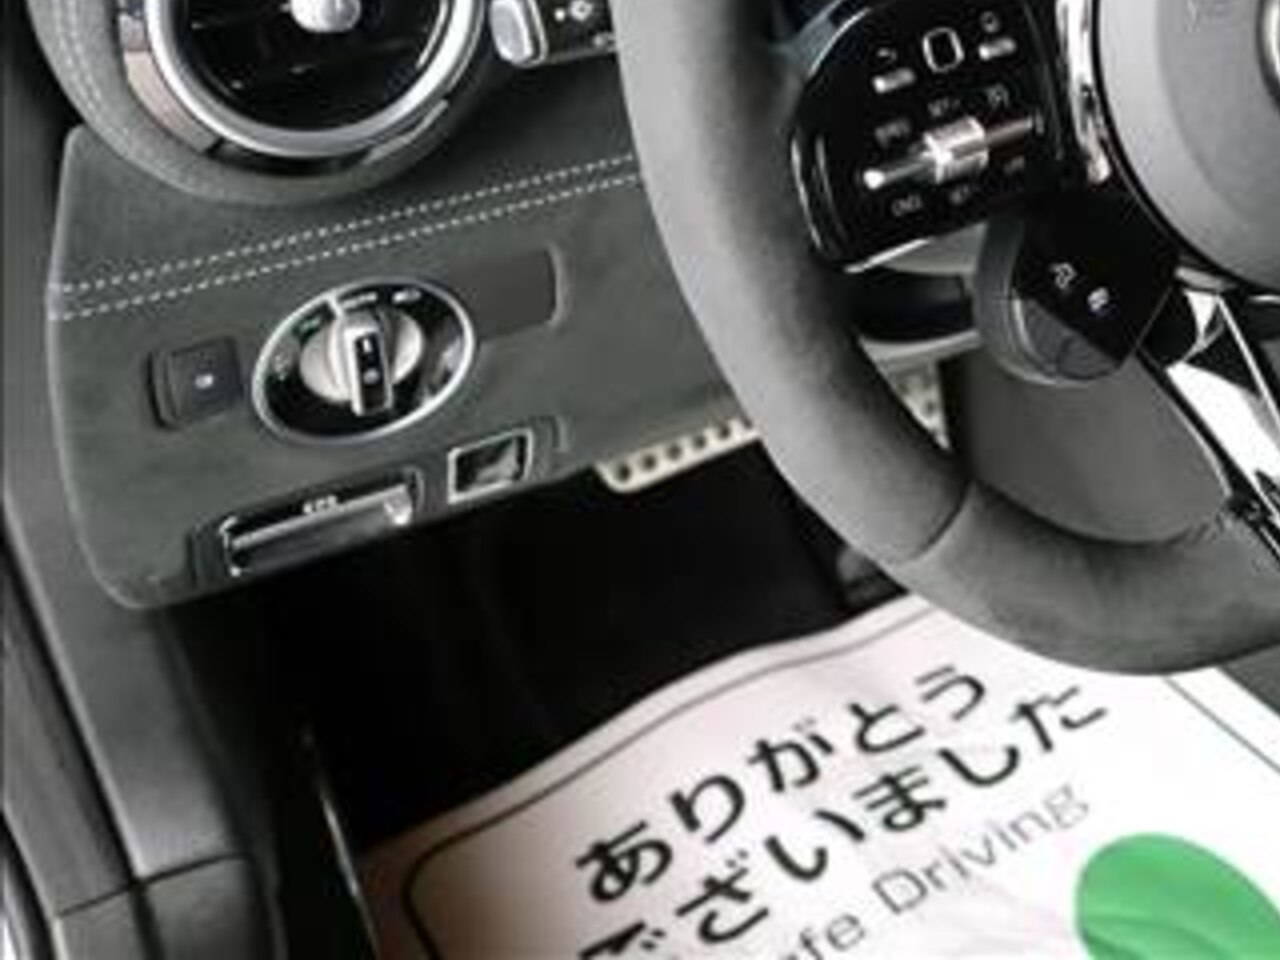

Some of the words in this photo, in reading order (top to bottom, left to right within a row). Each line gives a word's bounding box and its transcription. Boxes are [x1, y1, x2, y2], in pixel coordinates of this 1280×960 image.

[575, 665, 985, 902] ありがとう
[871, 783, 1089, 915] Driving
